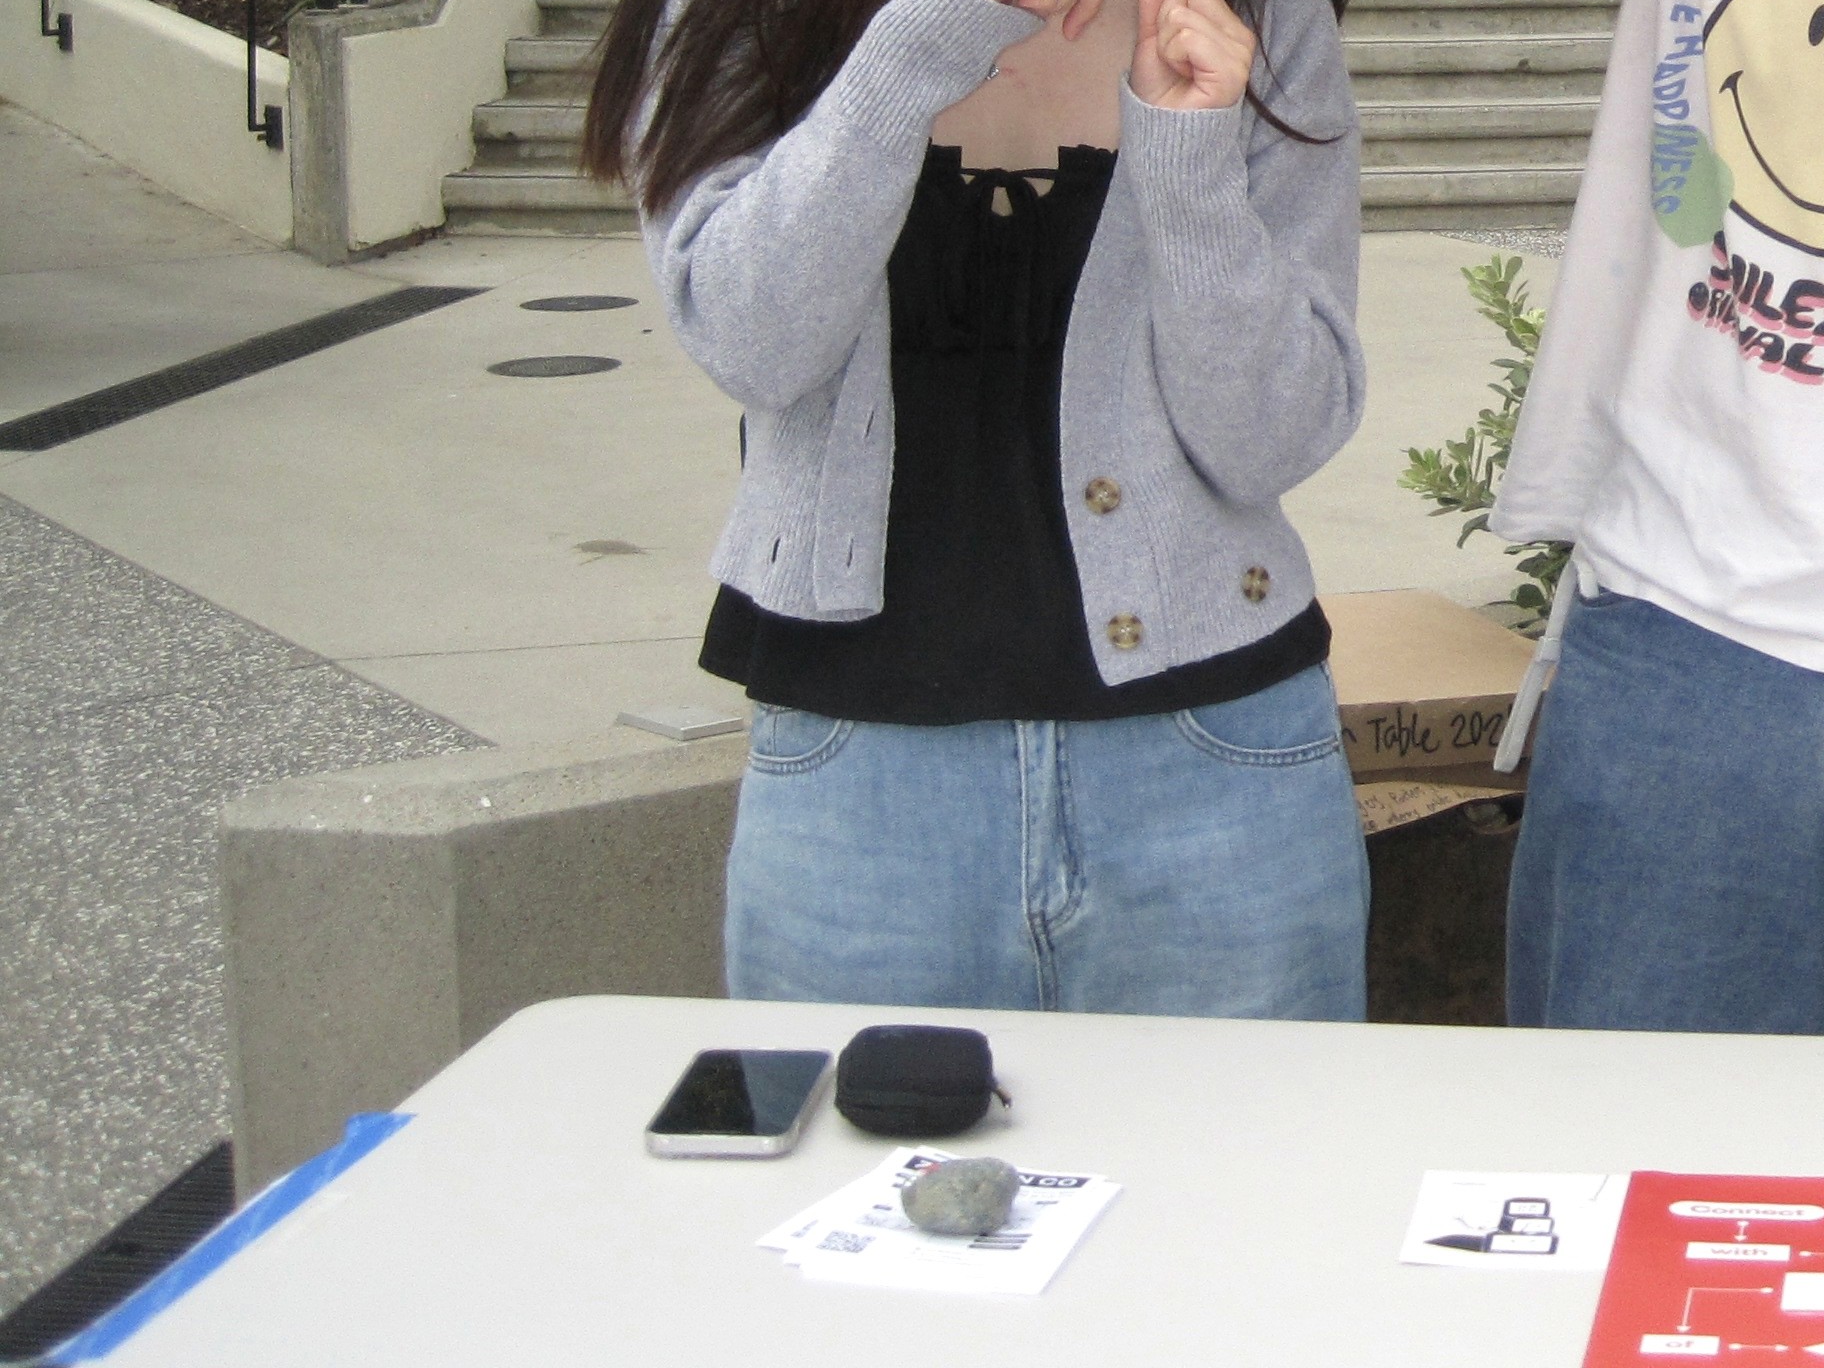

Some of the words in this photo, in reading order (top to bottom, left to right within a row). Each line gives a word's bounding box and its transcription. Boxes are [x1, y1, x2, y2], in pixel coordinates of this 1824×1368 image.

[1367, 706, 1440, 757] Table
[1451, 702, 1514, 748] 202
[1689, 1204, 1806, 1217] Connect
[1710, 1245, 1769, 1257] with
[1665, 1339, 1696, 1350] of
